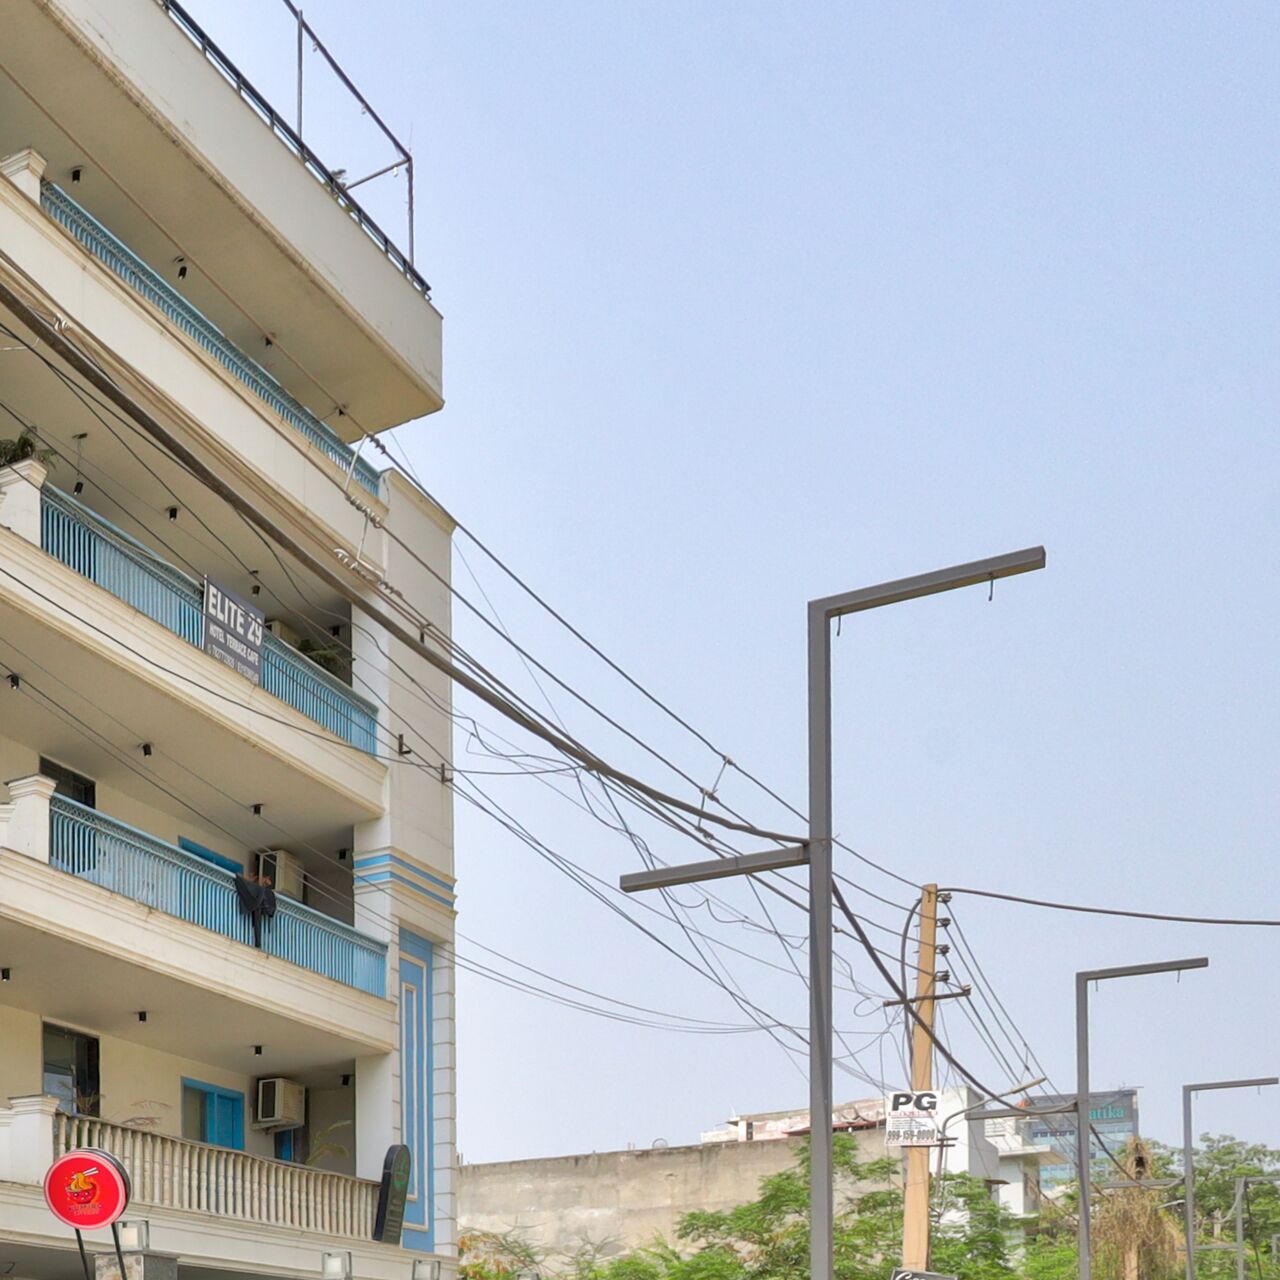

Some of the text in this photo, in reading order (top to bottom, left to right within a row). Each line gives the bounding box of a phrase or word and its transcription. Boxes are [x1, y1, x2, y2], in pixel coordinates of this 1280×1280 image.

[208, 584, 264, 647] ELITE 29
[892, 1092, 937, 1112] PG
